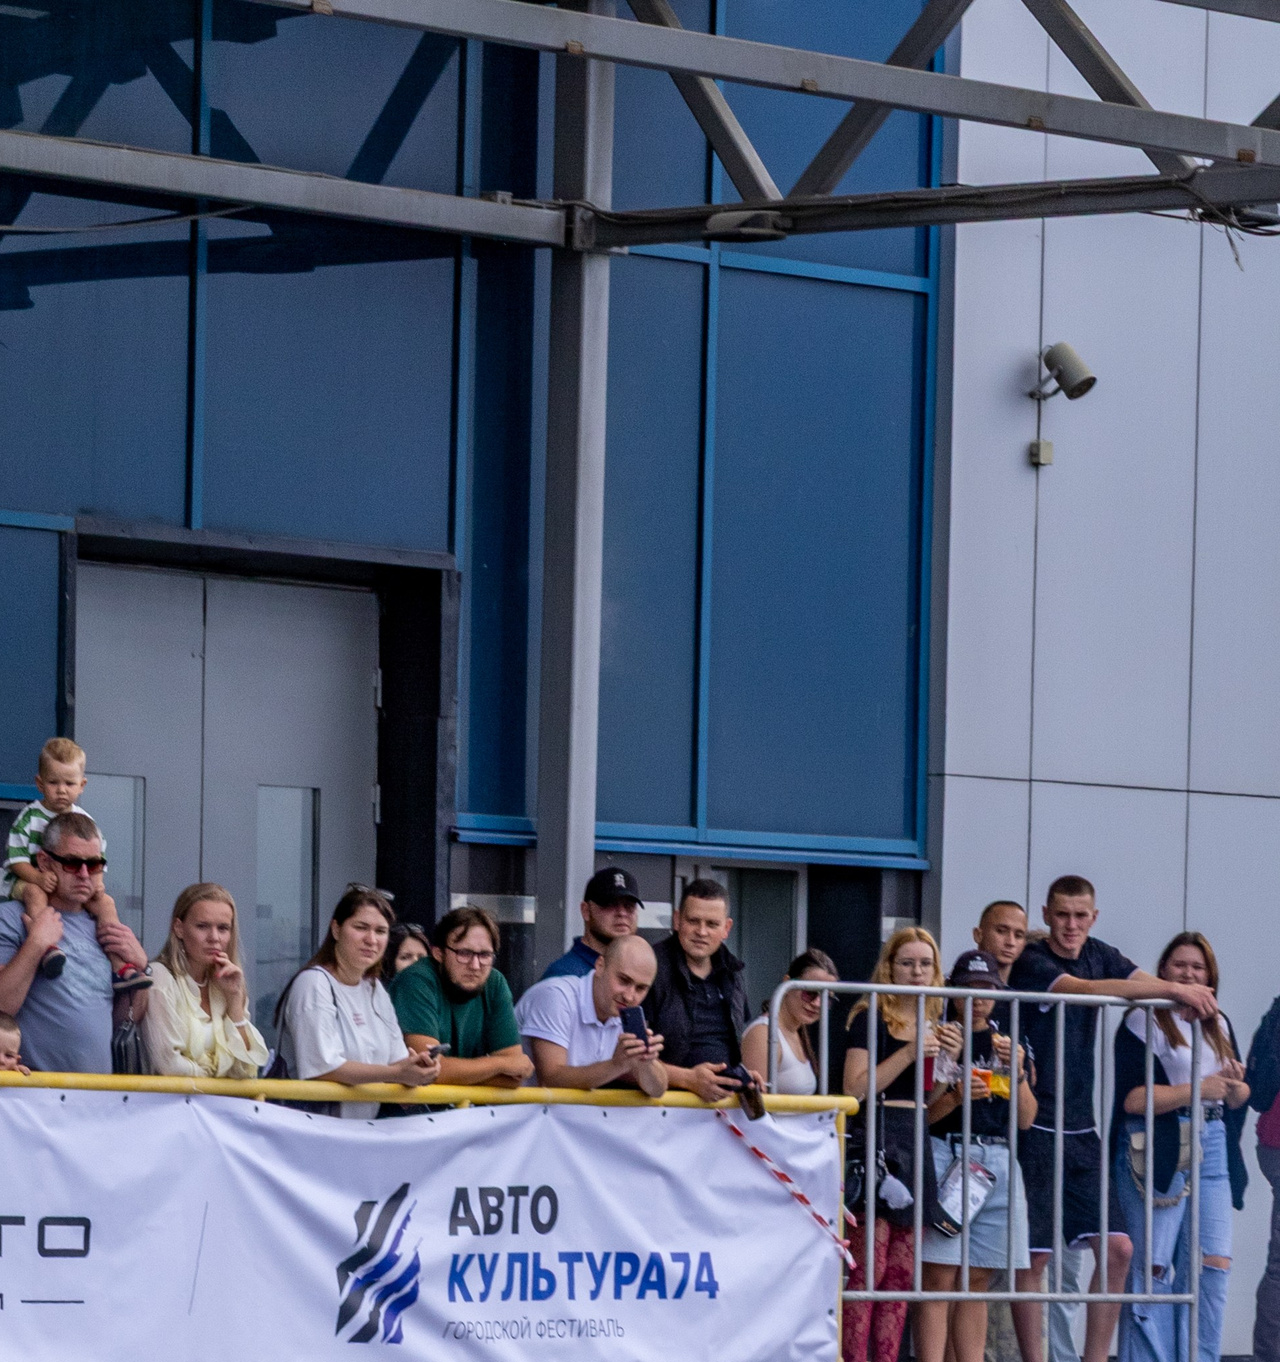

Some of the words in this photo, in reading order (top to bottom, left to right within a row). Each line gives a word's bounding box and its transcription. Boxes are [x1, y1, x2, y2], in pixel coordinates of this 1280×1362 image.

[448, 1185, 559, 1236] АВТО
[448, 1251, 721, 1303] КУЛЬТУРА74
[442, 1315, 532, 1343] ГОРОДСКОЙ
[536, 1318, 626, 1340] ФЕСТИВАЛЬ
